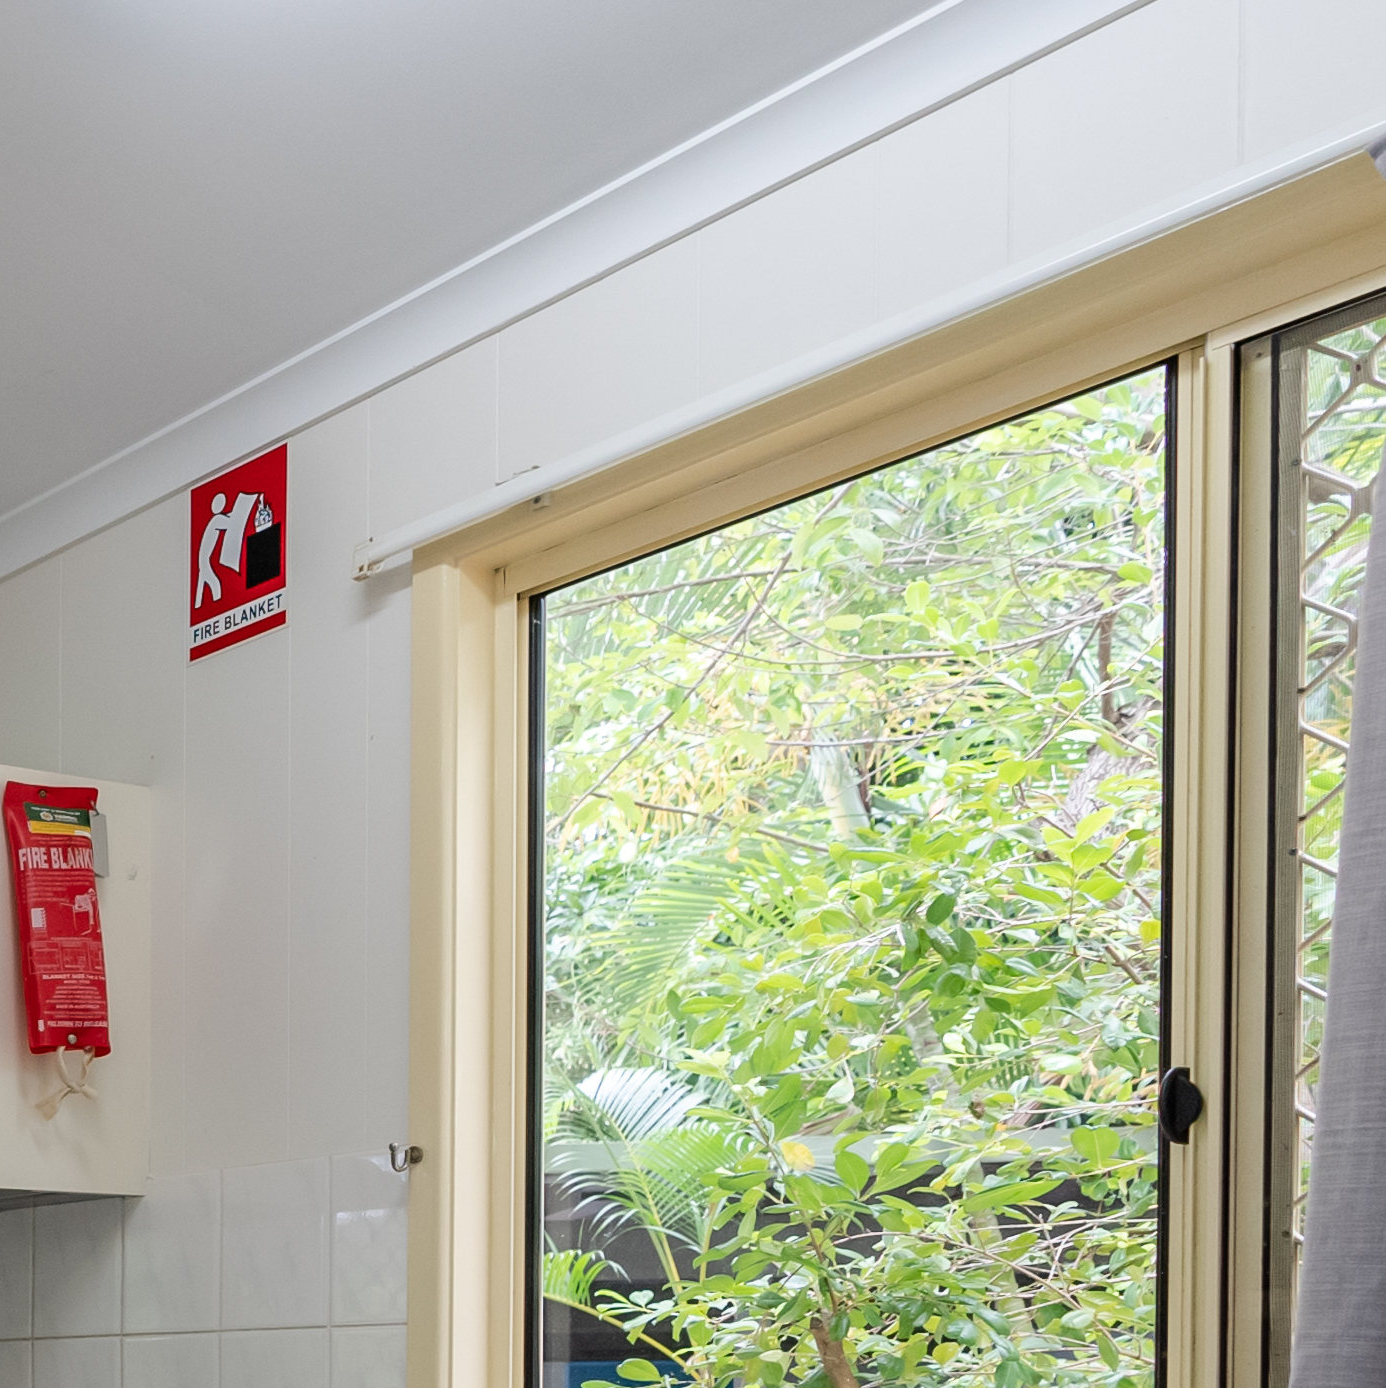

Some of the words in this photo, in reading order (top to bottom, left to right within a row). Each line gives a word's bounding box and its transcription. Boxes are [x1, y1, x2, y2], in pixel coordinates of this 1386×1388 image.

[193, 620, 221, 643] FIRE
[224, 593, 283, 631] BLANKET
[18, 847, 49, 871] FIRE
[49, 847, 94, 870] BLANK
